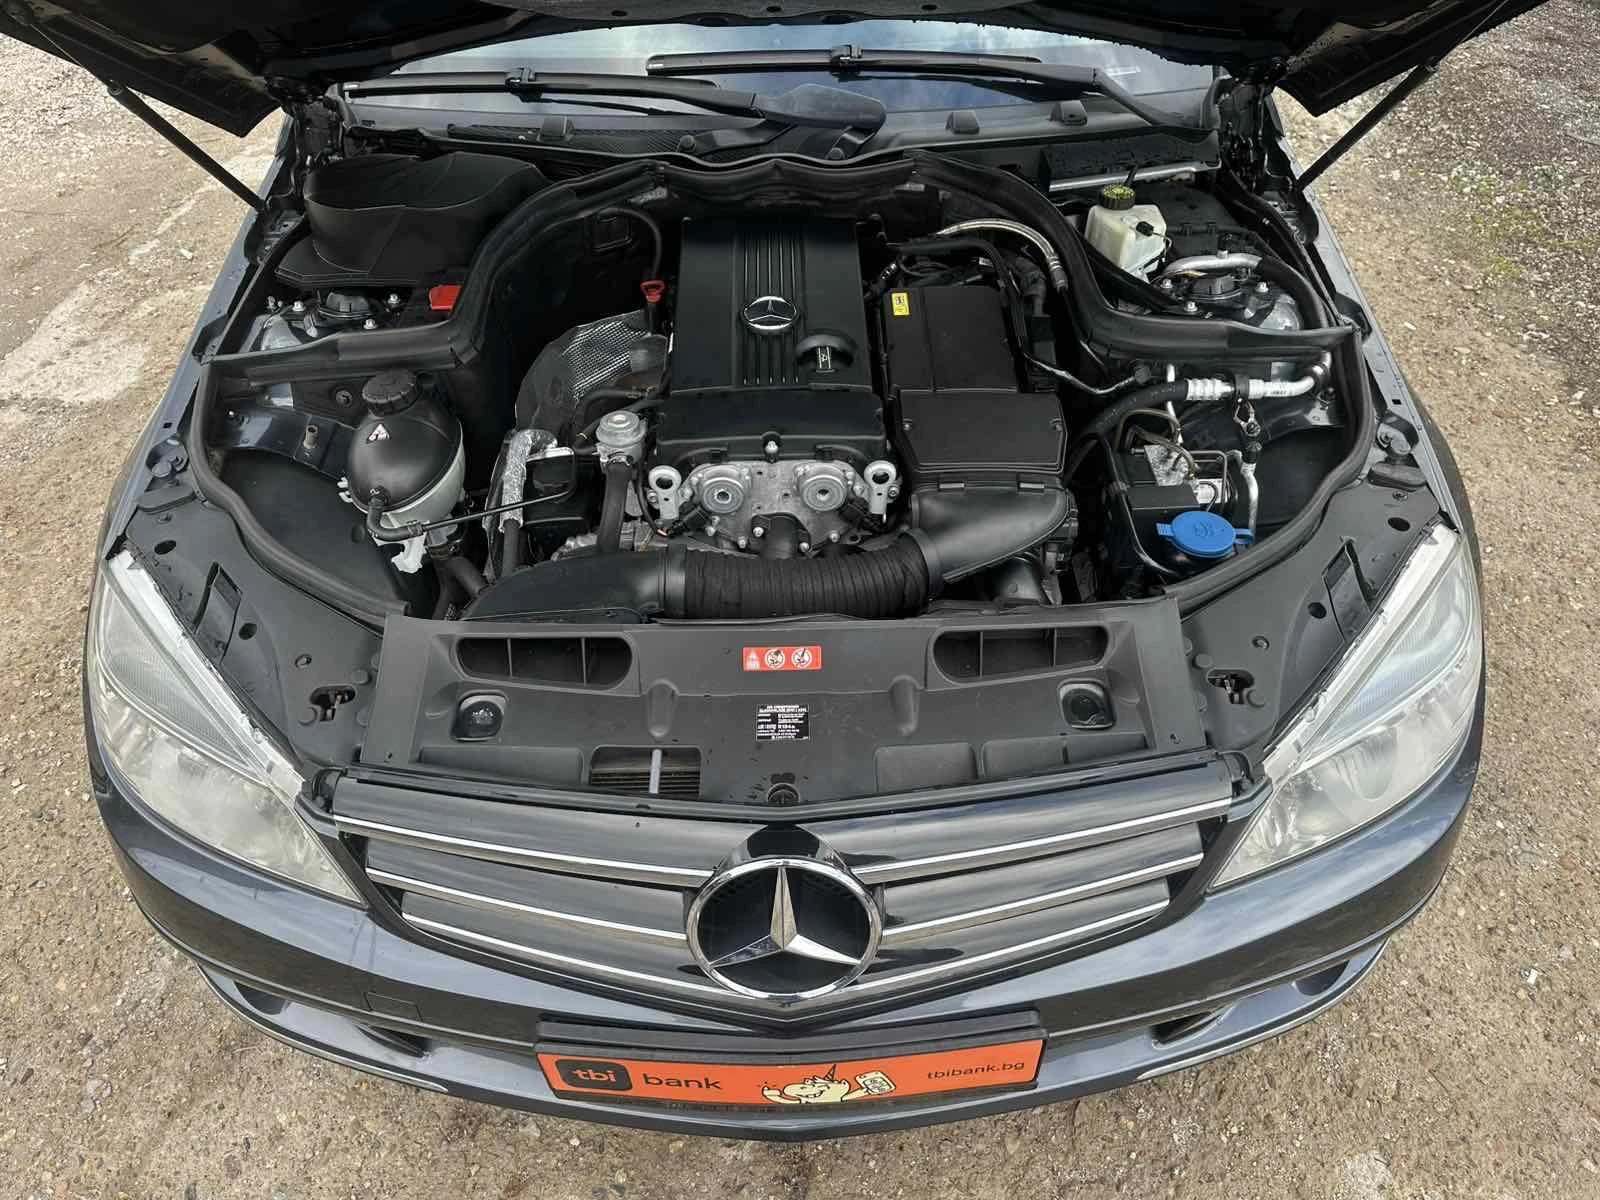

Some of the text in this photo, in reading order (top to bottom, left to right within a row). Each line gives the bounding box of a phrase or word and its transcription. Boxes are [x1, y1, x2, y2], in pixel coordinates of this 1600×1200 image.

[571, 1069, 722, 1090] tbi bank
[927, 1062, 1025, 1079] tbibank.bg
